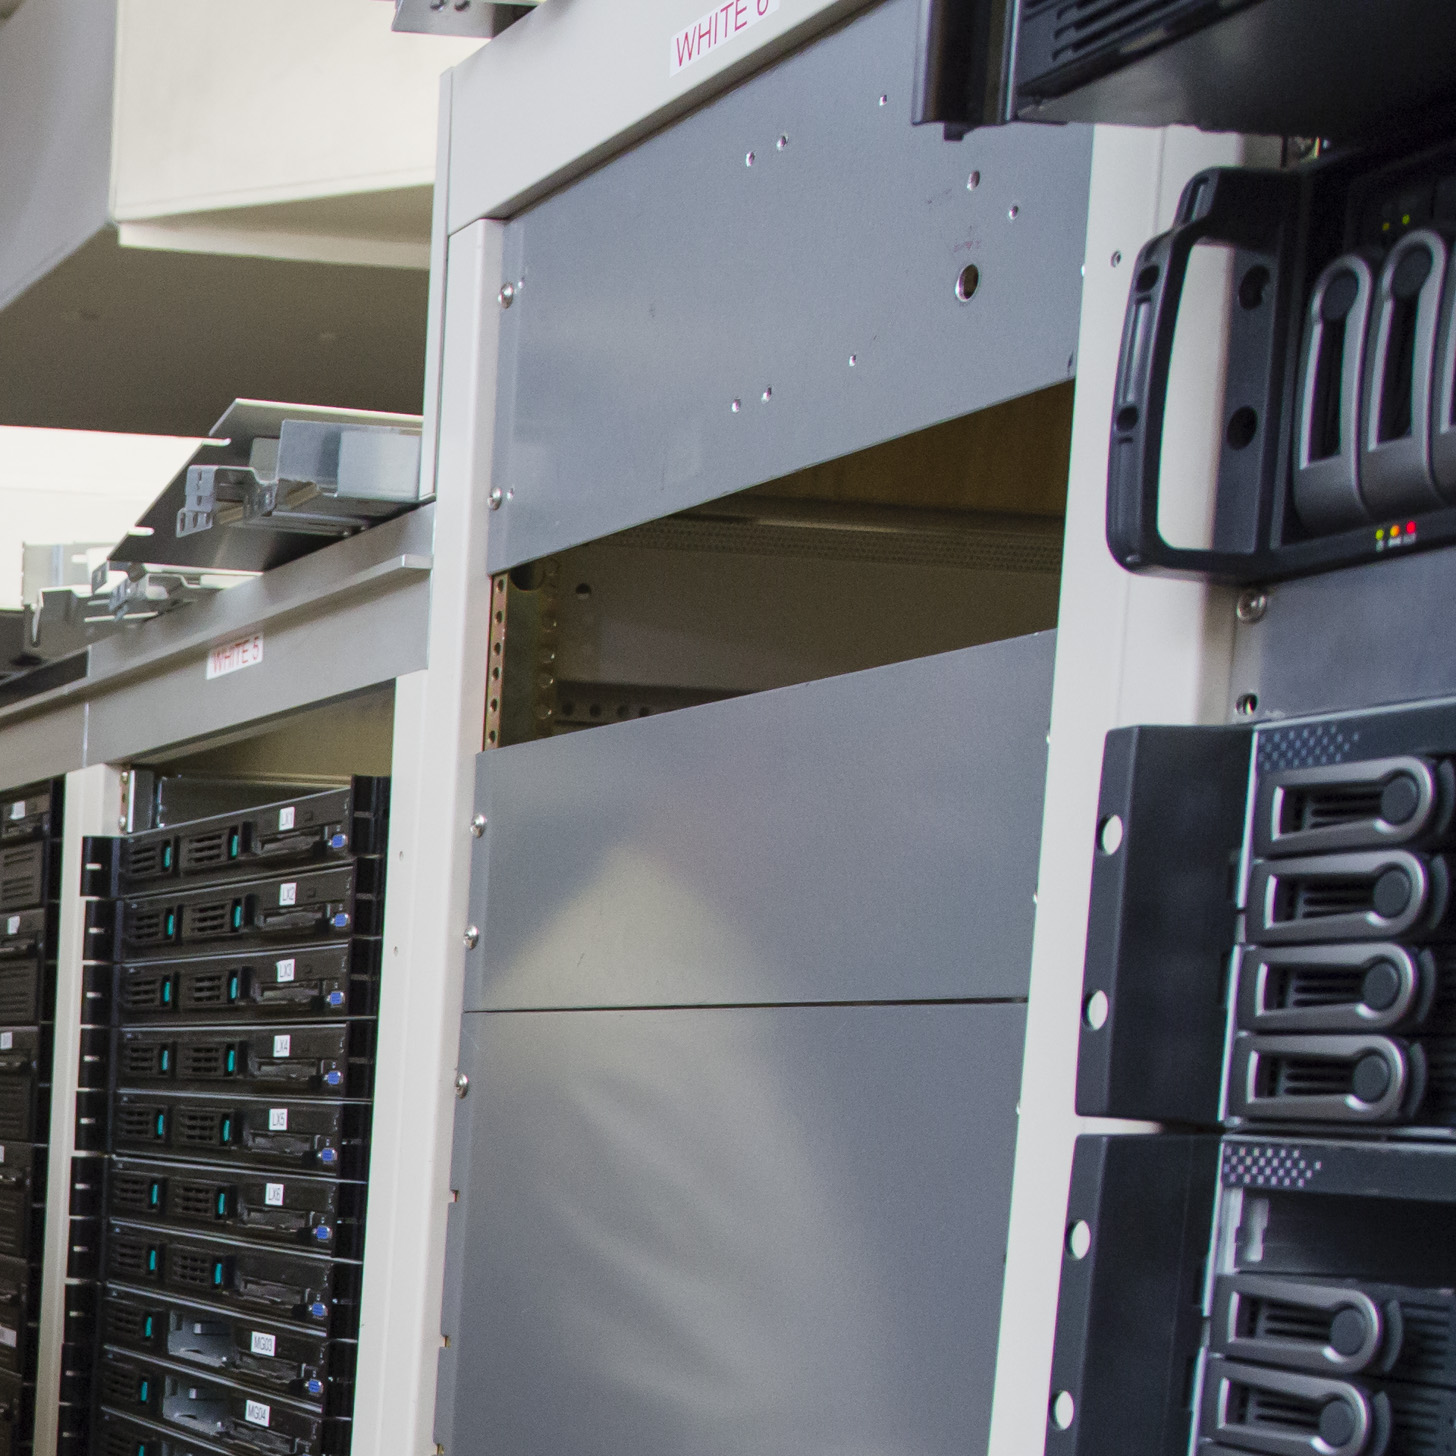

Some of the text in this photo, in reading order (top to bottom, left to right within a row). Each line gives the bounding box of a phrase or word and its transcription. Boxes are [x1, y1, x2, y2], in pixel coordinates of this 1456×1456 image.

[676, 0, 748, 67] WHITE
[213, 635, 260, 673] WHITE 5
[274, 1038, 287, 1053] LX4
